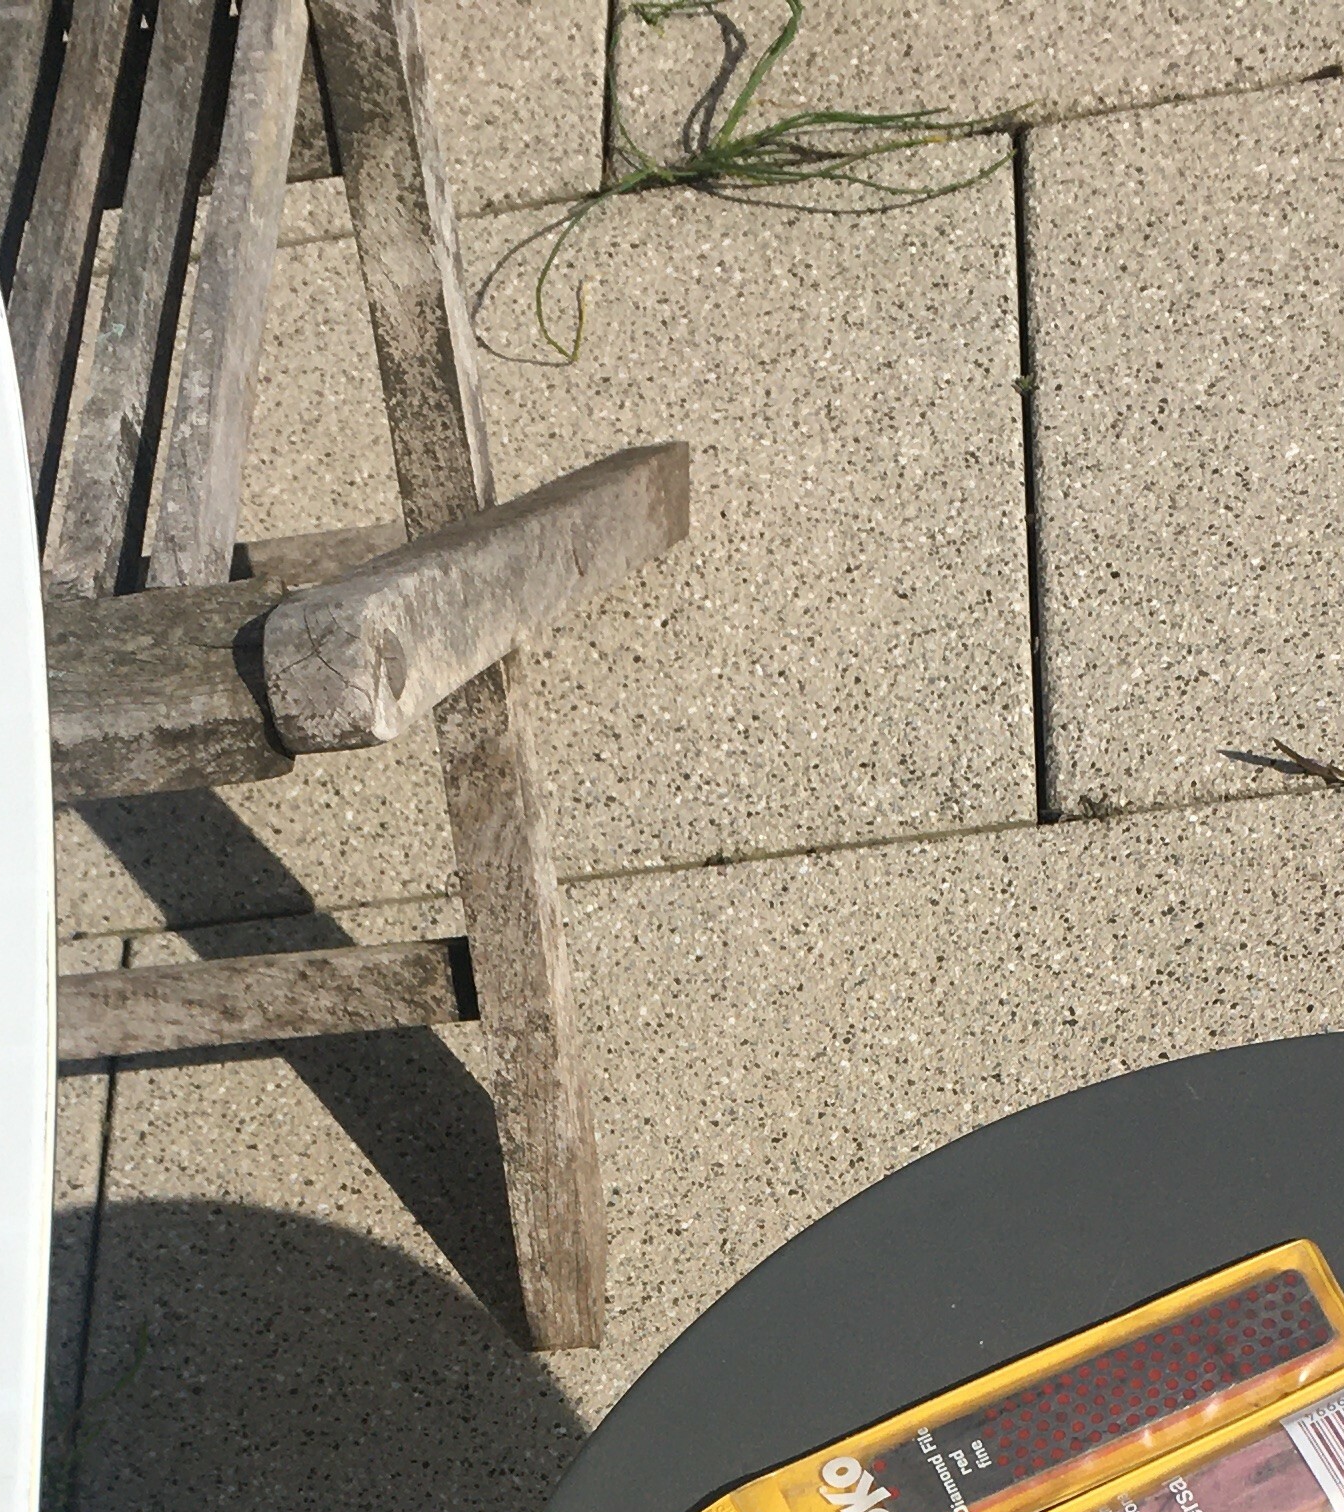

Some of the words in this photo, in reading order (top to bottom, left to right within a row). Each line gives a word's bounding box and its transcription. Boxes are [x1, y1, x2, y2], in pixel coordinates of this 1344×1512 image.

[917, 1426, 937, 1454] File
[971, 1439, 993, 1469] fine
[948, 1449, 973, 1476] red
